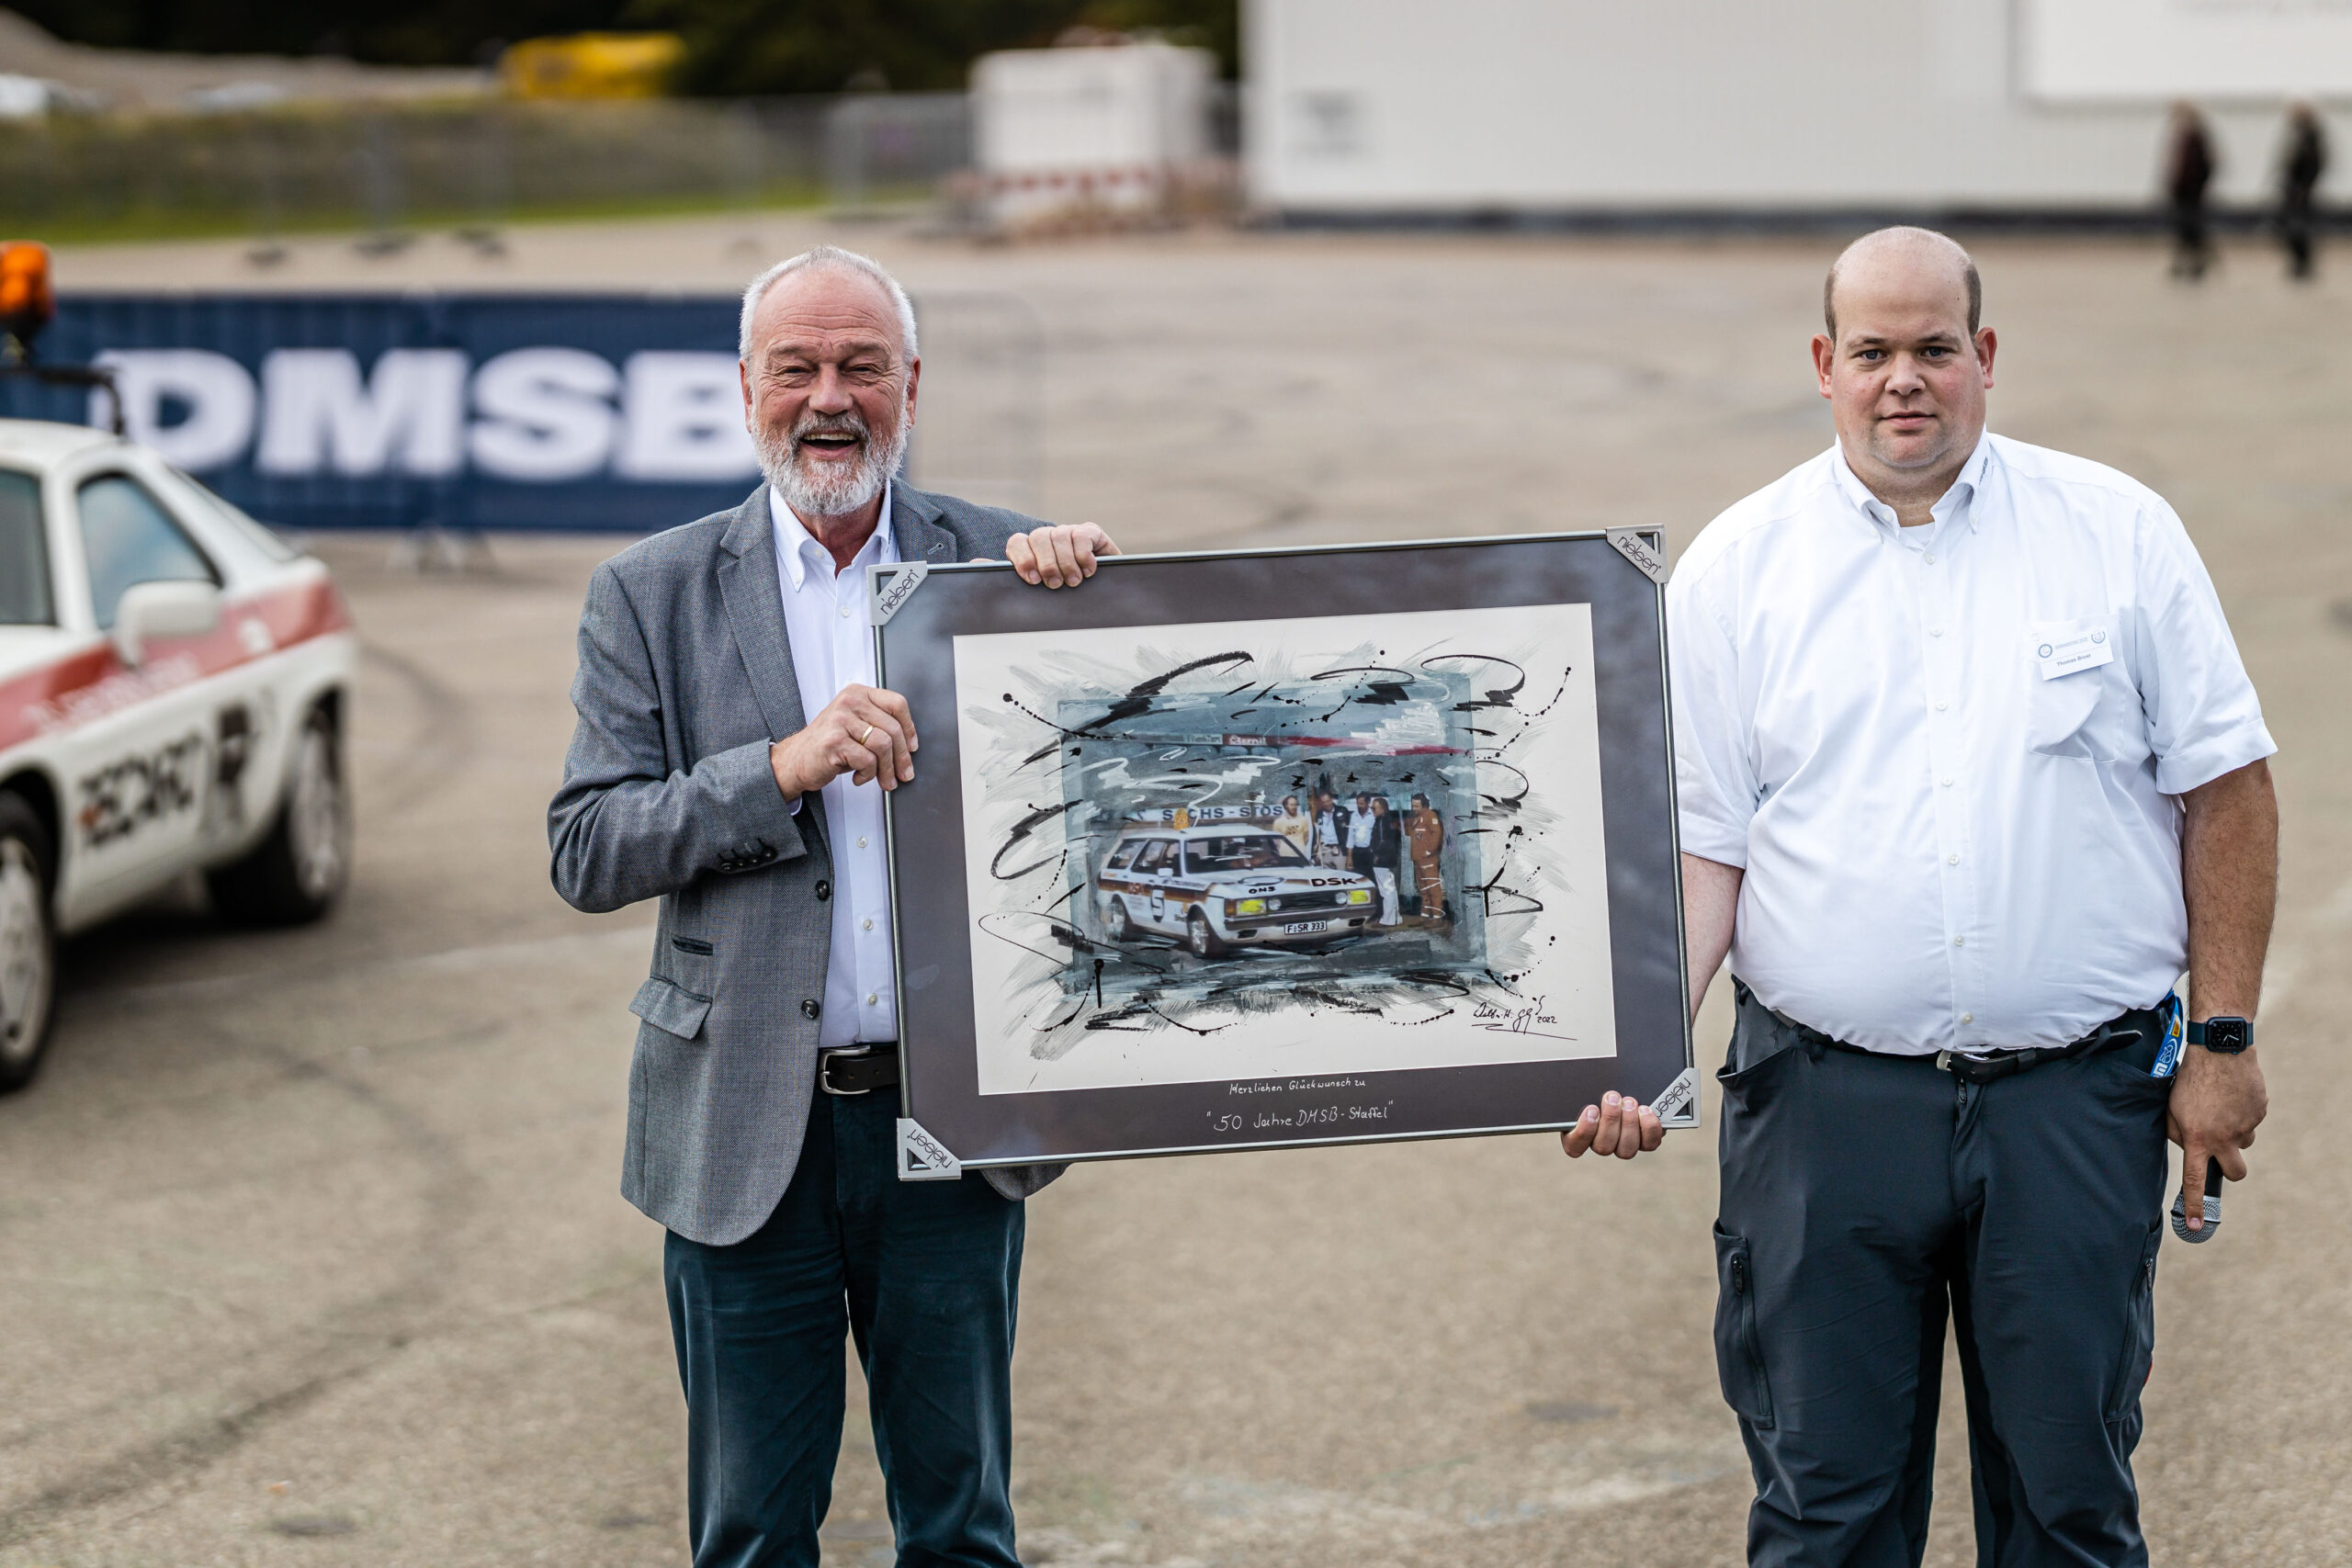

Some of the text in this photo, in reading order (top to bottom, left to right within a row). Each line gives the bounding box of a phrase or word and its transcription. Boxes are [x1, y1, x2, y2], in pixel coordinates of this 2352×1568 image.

[88, 345, 764, 483] DMSB
[1617, 536, 1659, 575] nielsen
[880, 569, 920, 615] nielsen
[1162, 808, 1224, 820] SCHS
[1249, 886, 1276, 895] ONS
[1310, 877, 1357, 887] DSK
[1311, 921, 1325, 931] 333
[1537, 1015, 1558, 1024] 2022
[1228, 1077, 1366, 1096] Herzlichen Glückwunsch zu
[1253, 1112, 1294, 1129] Jahre
[910, 1128, 954, 1169] nielsen
